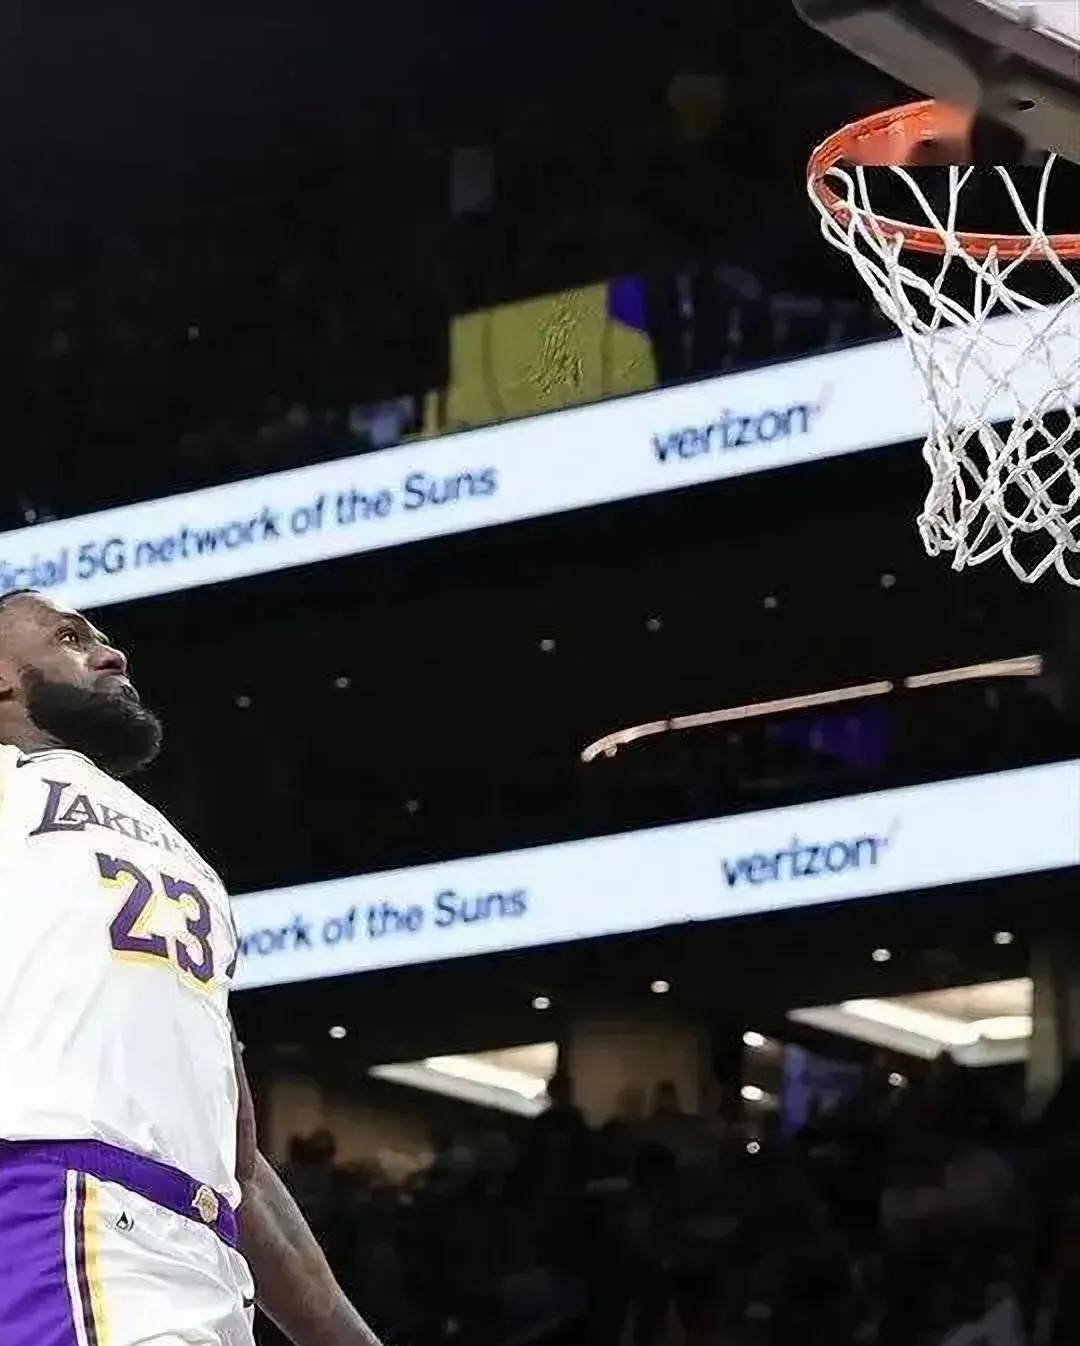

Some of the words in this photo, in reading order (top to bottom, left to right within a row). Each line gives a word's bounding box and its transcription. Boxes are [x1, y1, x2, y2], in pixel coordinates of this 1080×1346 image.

[653, 403, 810, 463] verizon
[77, 537, 126, 579] 5G
[134, 504, 280, 569] network
[291, 493, 325, 535] of
[337, 486, 392, 525] the
[403, 463, 499, 511] Suns
[722, 833, 880, 887] verizon
[94, 851, 215, 985] 23
[322, 903, 357, 944] of
[368, 899, 424, 937] the
[434, 889, 529, 928] Suns
